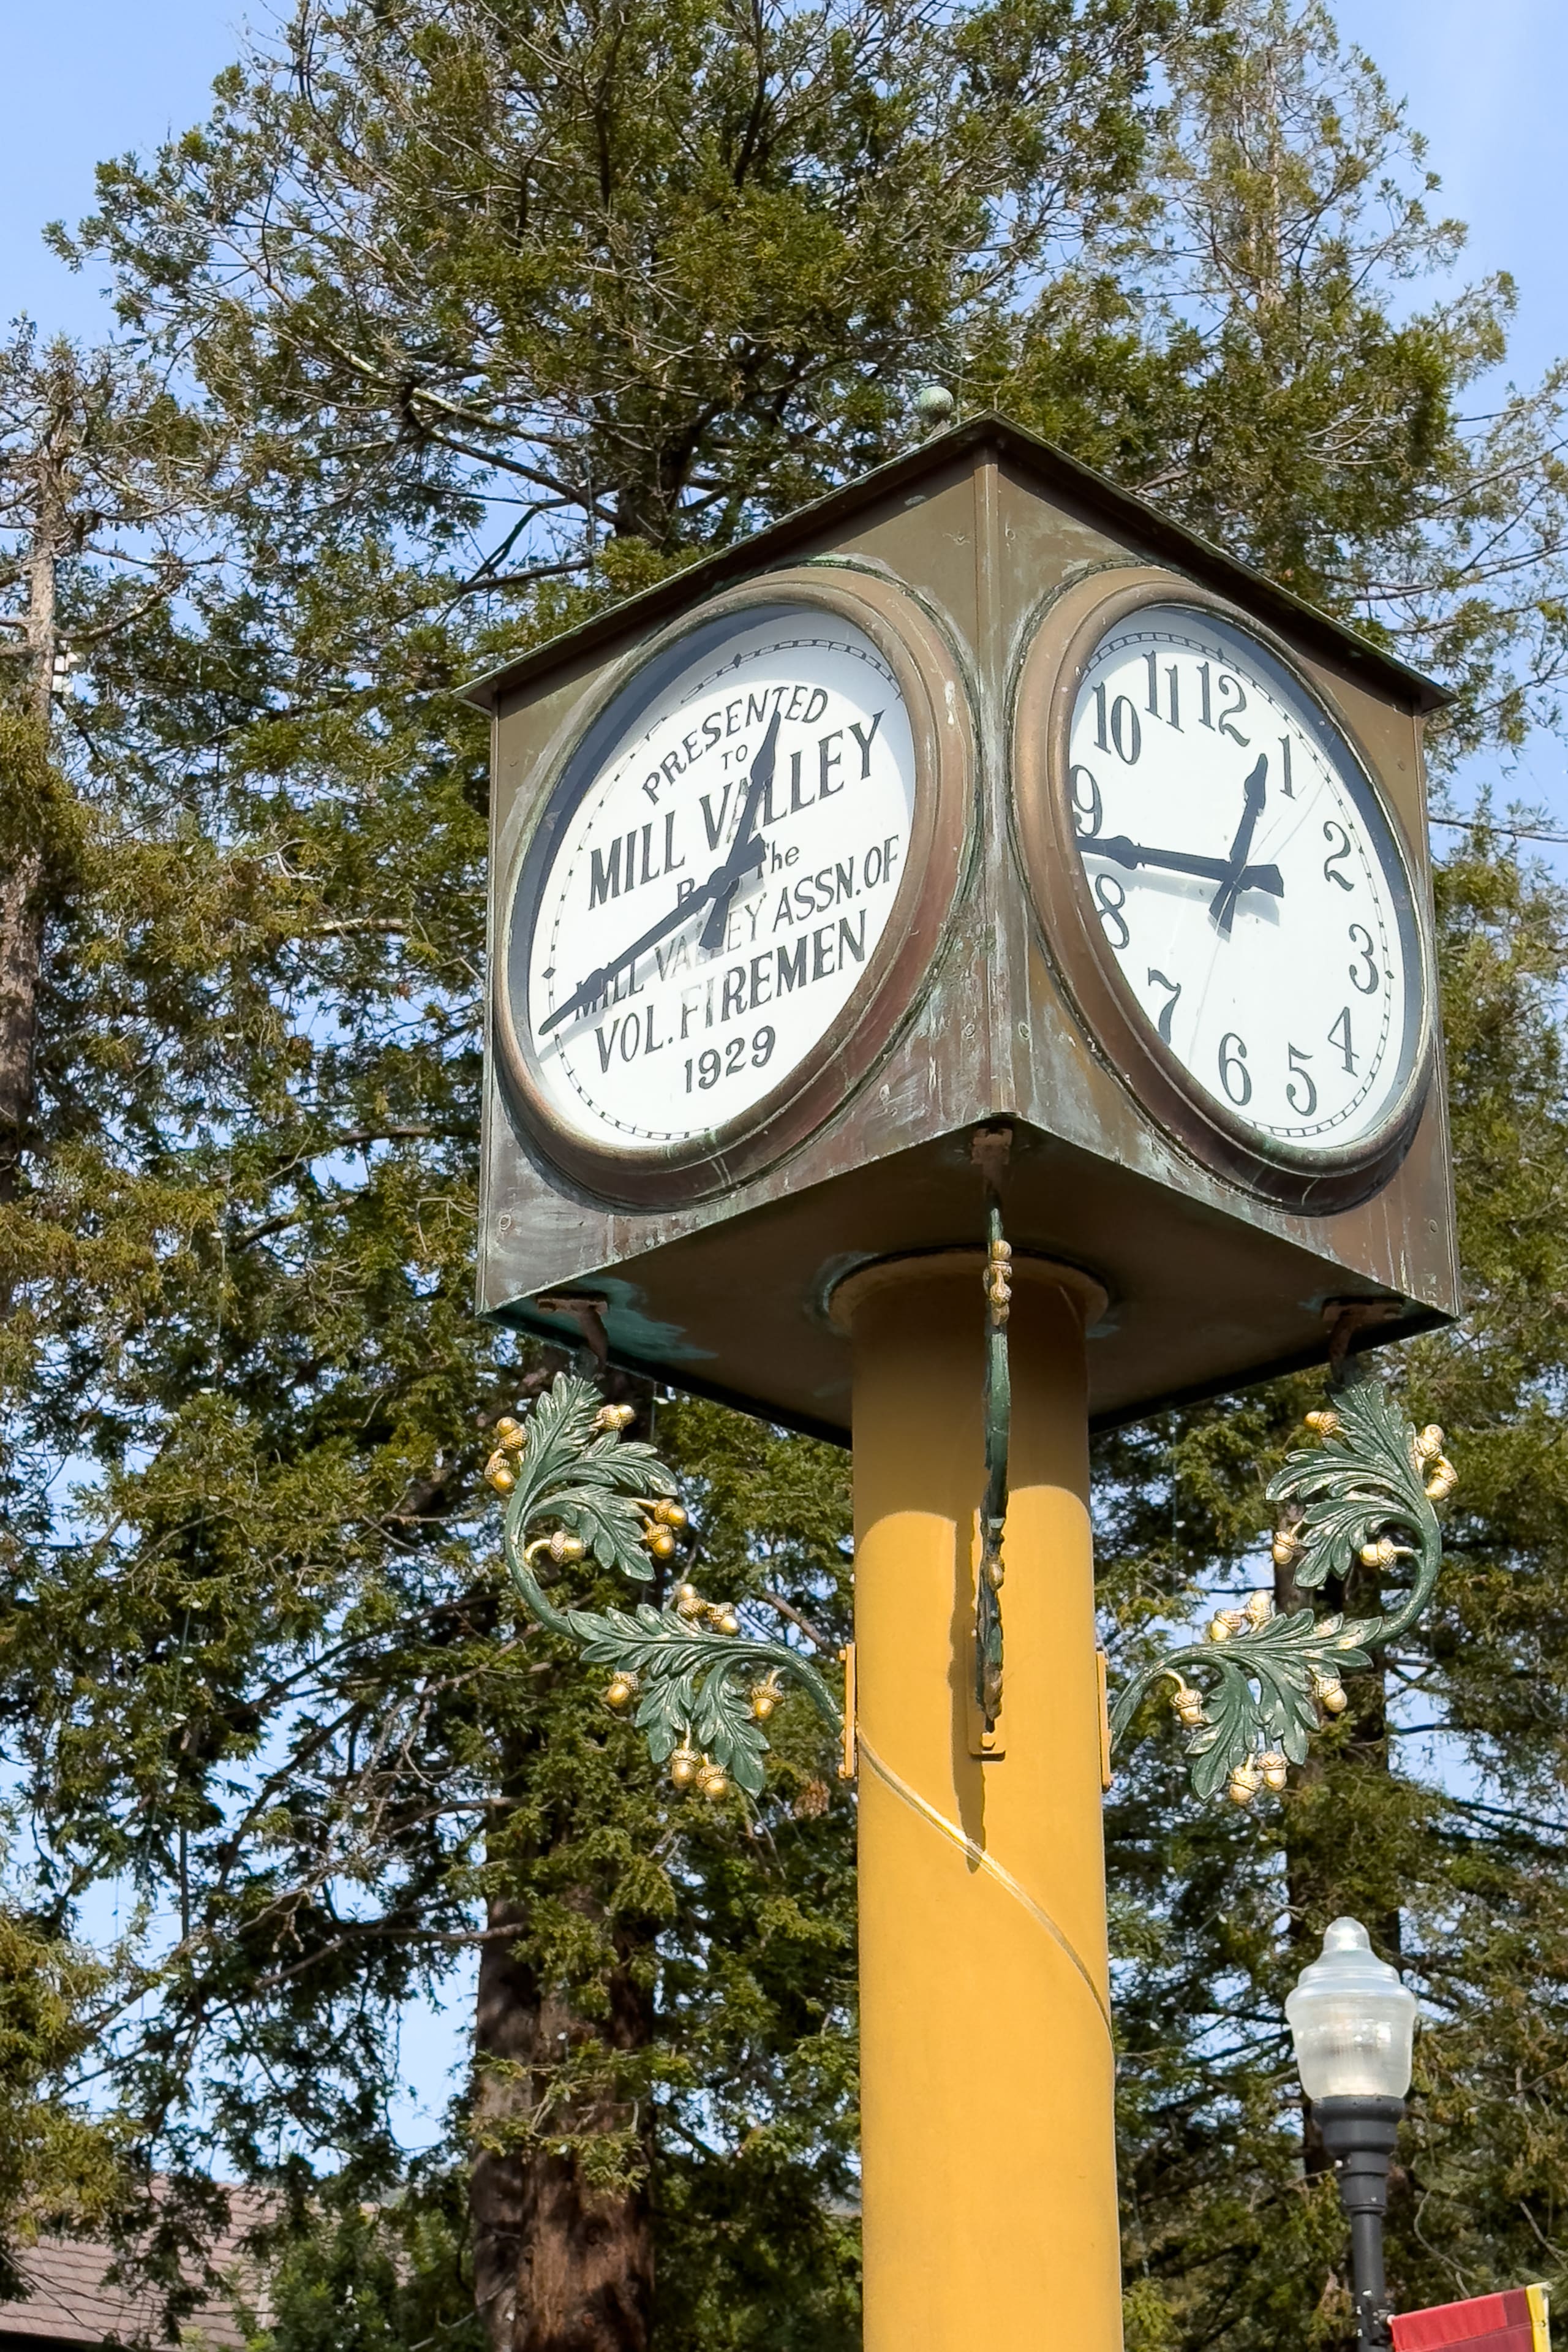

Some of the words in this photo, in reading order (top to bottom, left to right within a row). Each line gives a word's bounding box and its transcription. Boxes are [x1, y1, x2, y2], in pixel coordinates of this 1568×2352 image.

[1093, 681, 1141, 765] 10
[1143, 651, 1184, 733] 11
[1197, 662, 1250, 746] 12
[641, 685, 828, 805] PRESENTED
[721, 744, 748, 770] TO
[1278, 736, 1296, 800] 1
[1069, 765, 1102, 837] 9
[588, 810, 685, 911] MILL
[1323, 822, 1354, 891] 2
[1095, 874, 1129, 949] 8
[595, 1004, 673, 1073] VOL.
[680, 909, 867, 1039] FIREMEN
[1349, 924, 1379, 994] 3
[1148, 967, 1181, 1045] 7
[1327, 1007, 1359, 1078] 4
[685, 1026, 775, 1093] 1929
[1218, 1032, 1251, 1106] 6
[1287, 1042, 1316, 1117] 5
